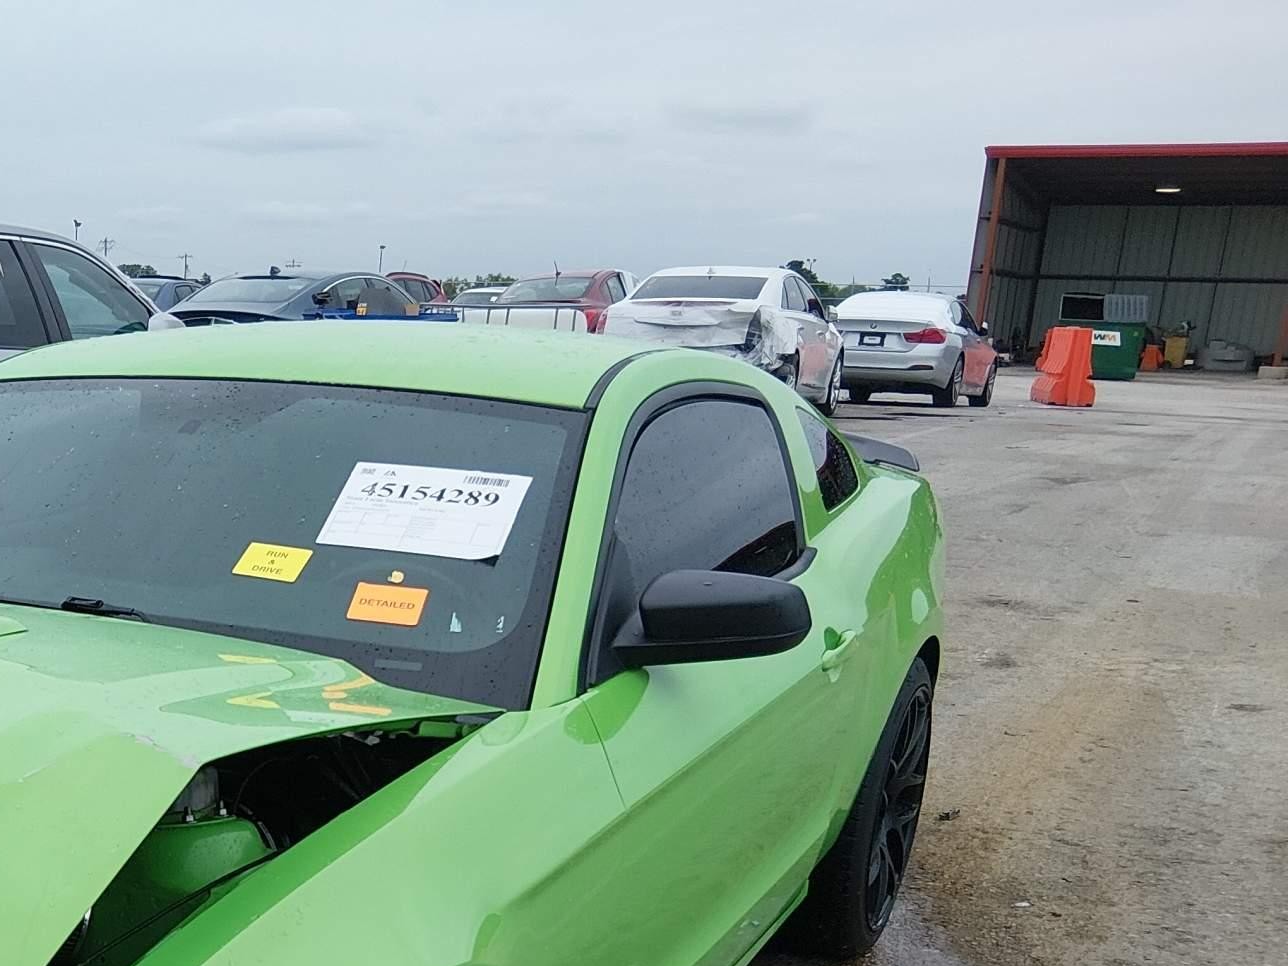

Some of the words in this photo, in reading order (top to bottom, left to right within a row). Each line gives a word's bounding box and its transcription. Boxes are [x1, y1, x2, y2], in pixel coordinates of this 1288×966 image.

[361, 482, 500, 507] 45154289
[266, 550, 289, 560] RUN
[251, 564, 284, 576] DRIVE
[358, 597, 416, 610] DETAILED
